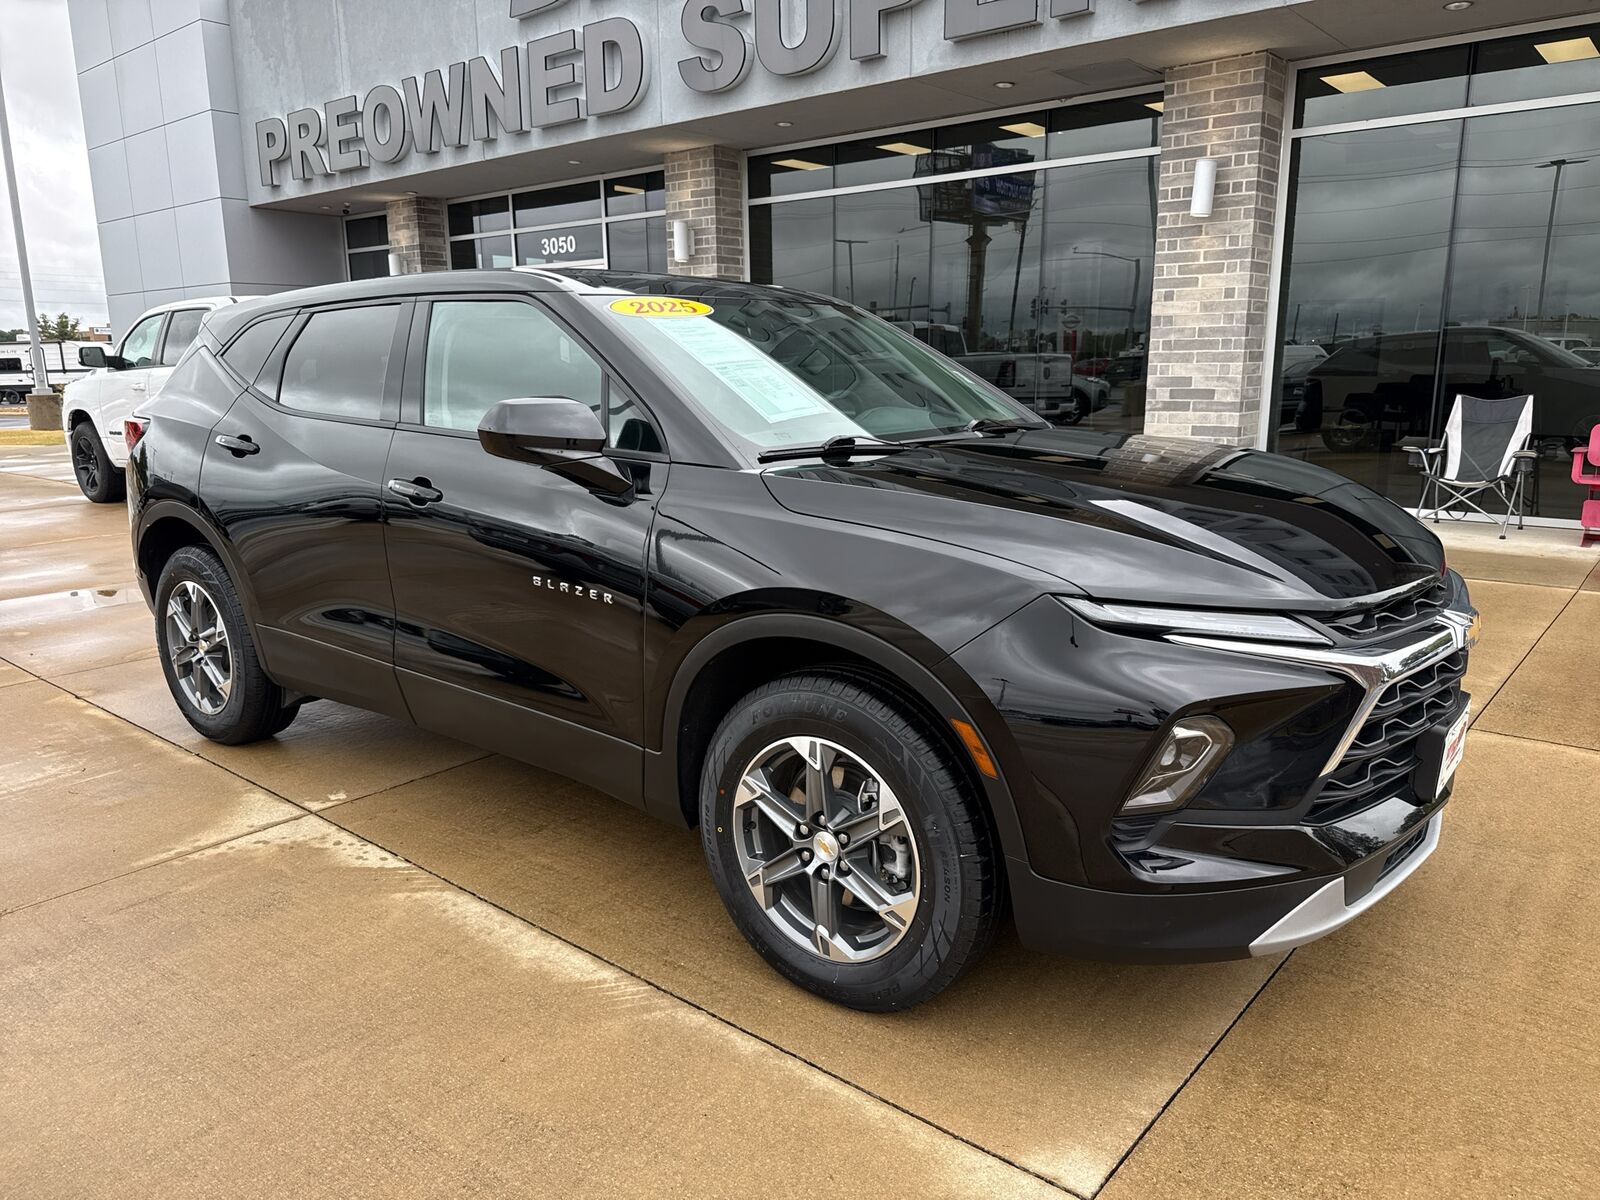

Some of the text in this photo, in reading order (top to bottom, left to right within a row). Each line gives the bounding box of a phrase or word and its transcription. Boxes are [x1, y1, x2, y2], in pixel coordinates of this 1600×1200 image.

[256, 17, 649, 187] PREOWNED
[541, 235, 576, 256] 3050
[629, 301, 699, 315] 2025
[532, 575, 614, 605] BLAZER
